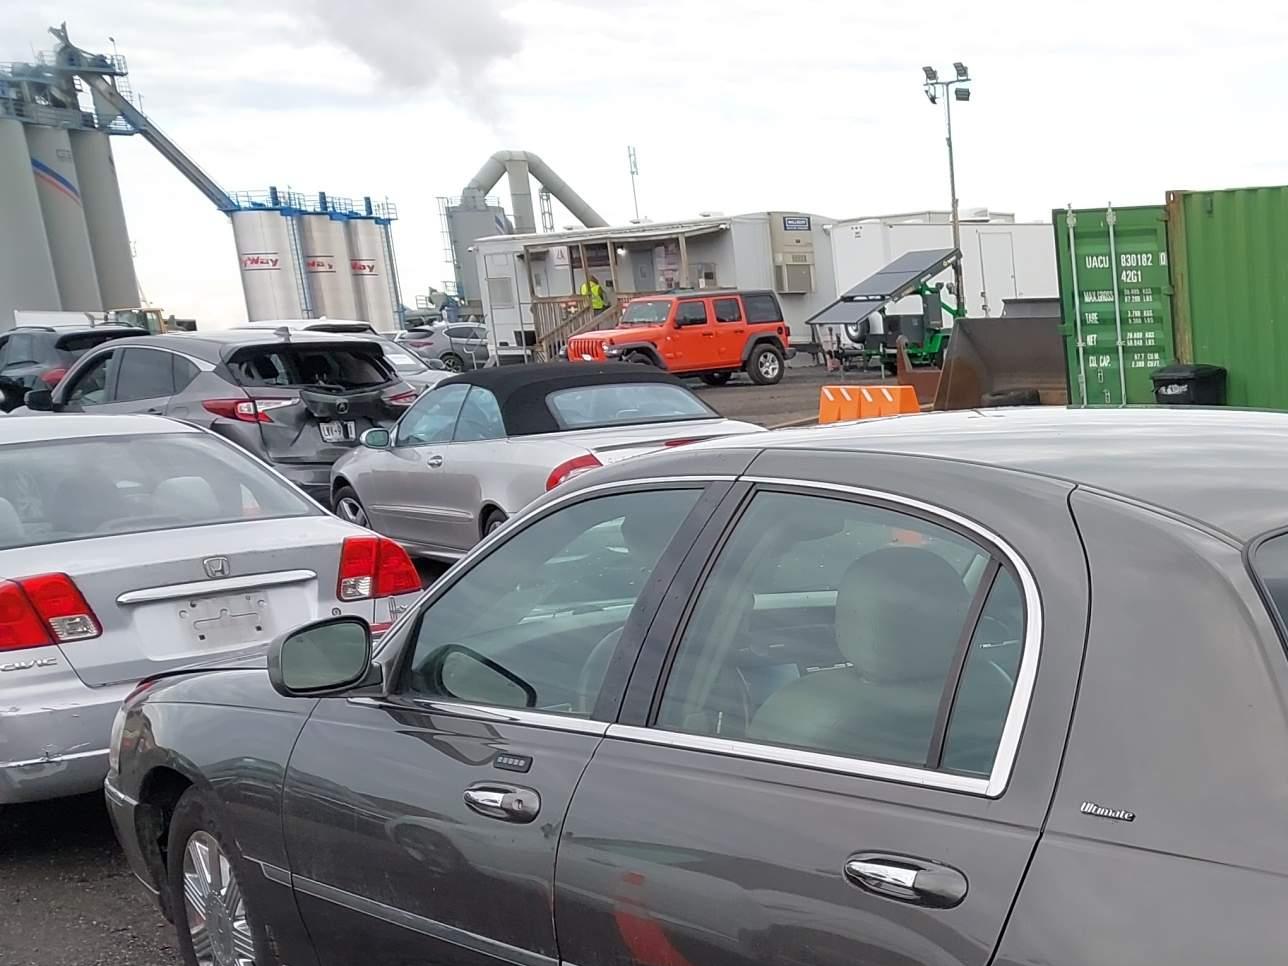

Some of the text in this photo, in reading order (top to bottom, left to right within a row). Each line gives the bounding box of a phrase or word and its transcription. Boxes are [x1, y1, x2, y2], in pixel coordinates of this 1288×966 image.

[1085, 255, 1109, 269] UACU
[1120, 253, 1152, 267] 830182
[1121, 270, 1142, 283] 42G1
[0, 657, 57, 671] CIVIC
[1080, 801, 1136, 822] Ultimate
